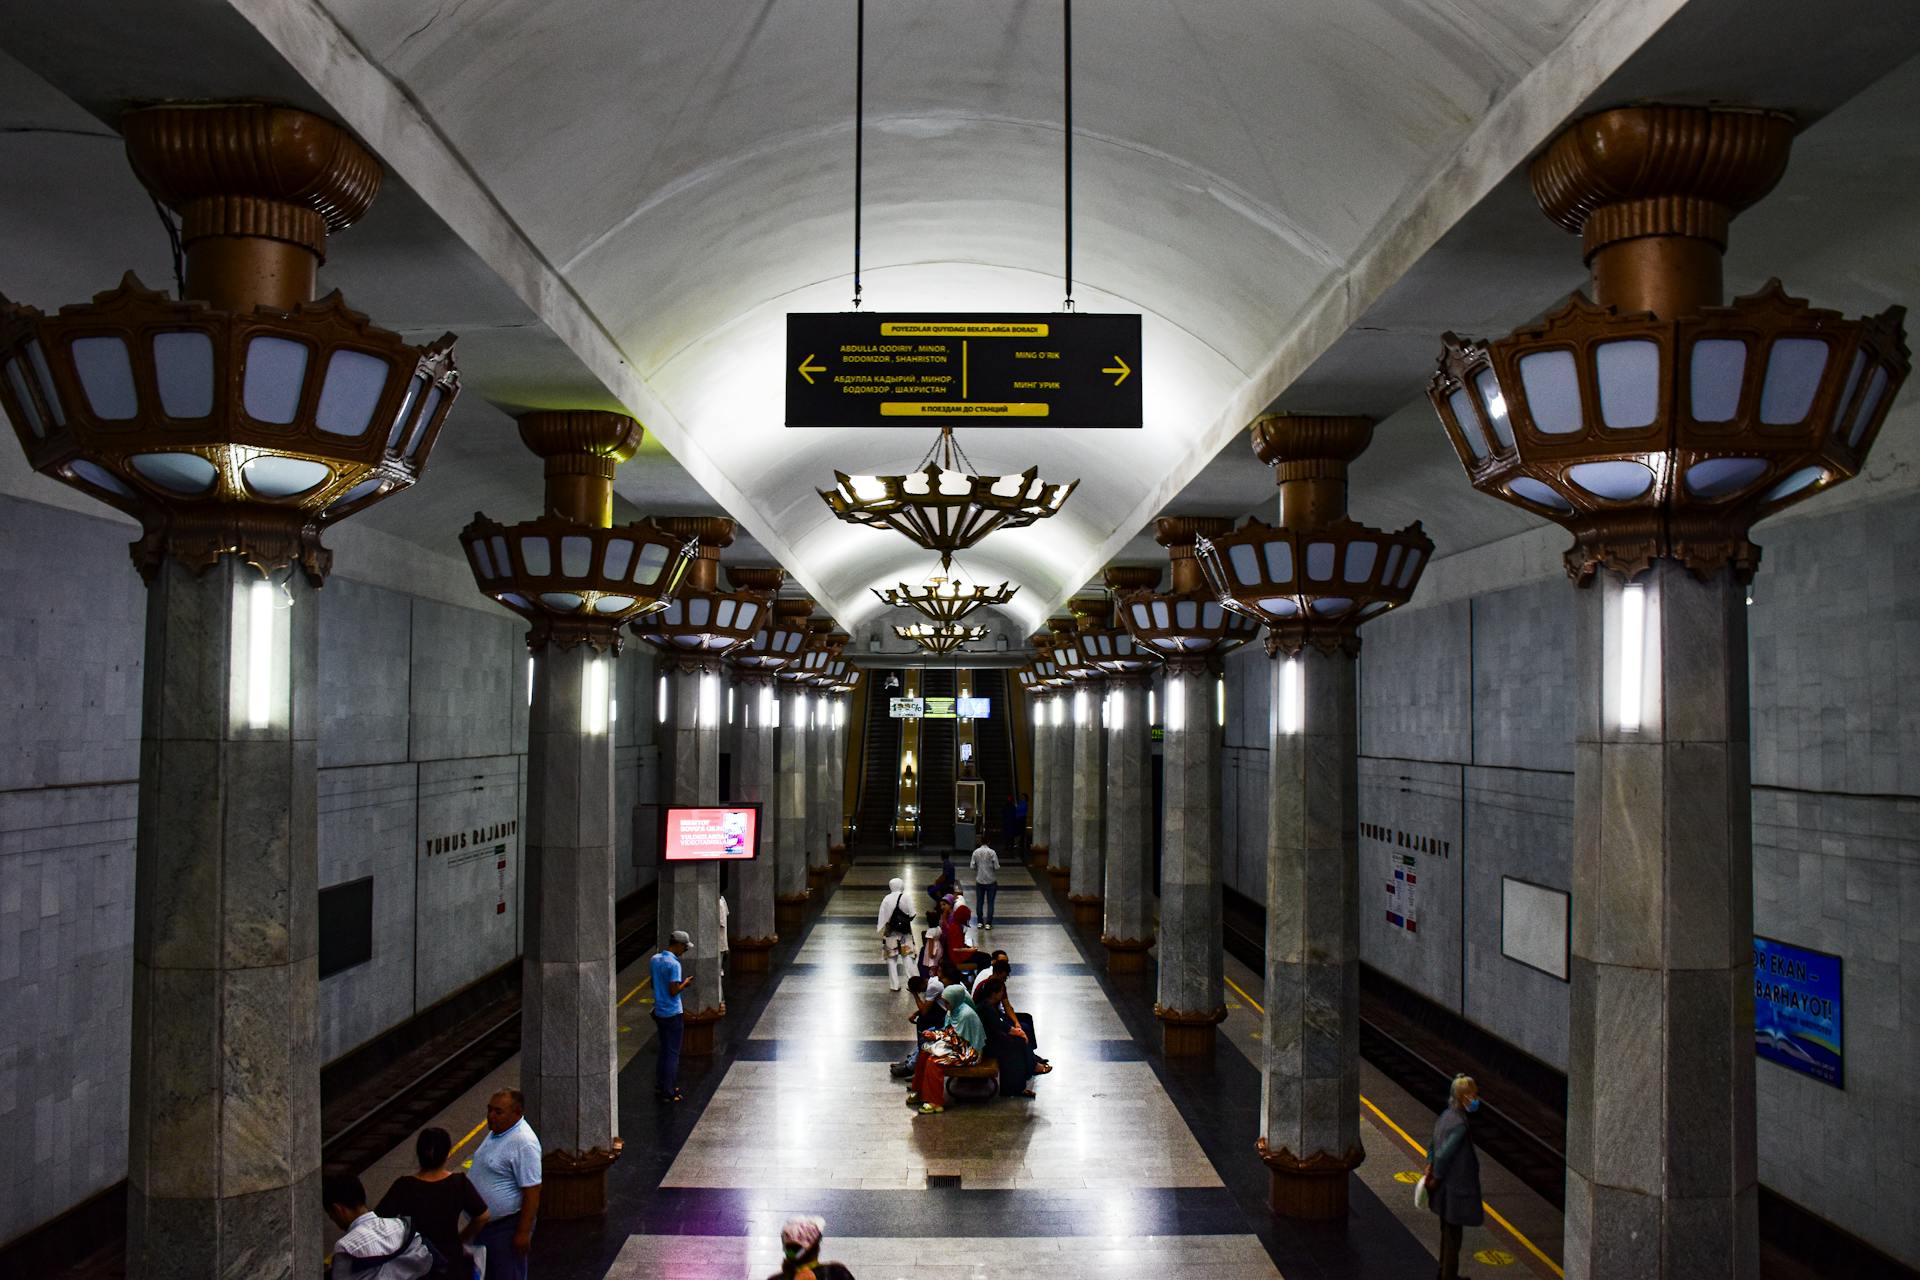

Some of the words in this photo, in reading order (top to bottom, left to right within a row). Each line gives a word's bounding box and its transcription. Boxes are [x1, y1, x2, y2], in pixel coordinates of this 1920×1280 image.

[840, 345, 878, 353] ABDULLA
[879, 345, 913, 353] QODIRIY
[918, 345, 946, 353] MINOR
[843, 355, 890, 363] BODOMZOR
[895, 355, 947, 363] SHAHRISTON
[1015, 351, 1037, 359] MING
[834, 375, 872, 384] АБДУЛЛА
[874, 374, 916, 384] КАДЫРИЙ
[921, 375, 952, 383] МИНОР
[1013, 381, 1037, 389] МИНГ
[1039, 381, 1061, 389] УРИК
[843, 386, 890, 394] БОДОМЗОР
[895, 386, 946, 394] ШАХРИСТАН
[927, 405, 962, 413] ПОЕЗДАМ
[963, 405, 973, 413] ДО
[974, 405, 1008, 413] СТАНЦИЙ
[426, 833, 467, 857] YUNUS
[472, 820, 517, 845] RAJABIY
[1360, 822, 1392, 844] YUNUS
[1398, 831, 1450, 859] RAJABIY
[1770, 955, 1807, 983] EKAN
[1755, 980, 1834, 1021] BARHAYOT!
